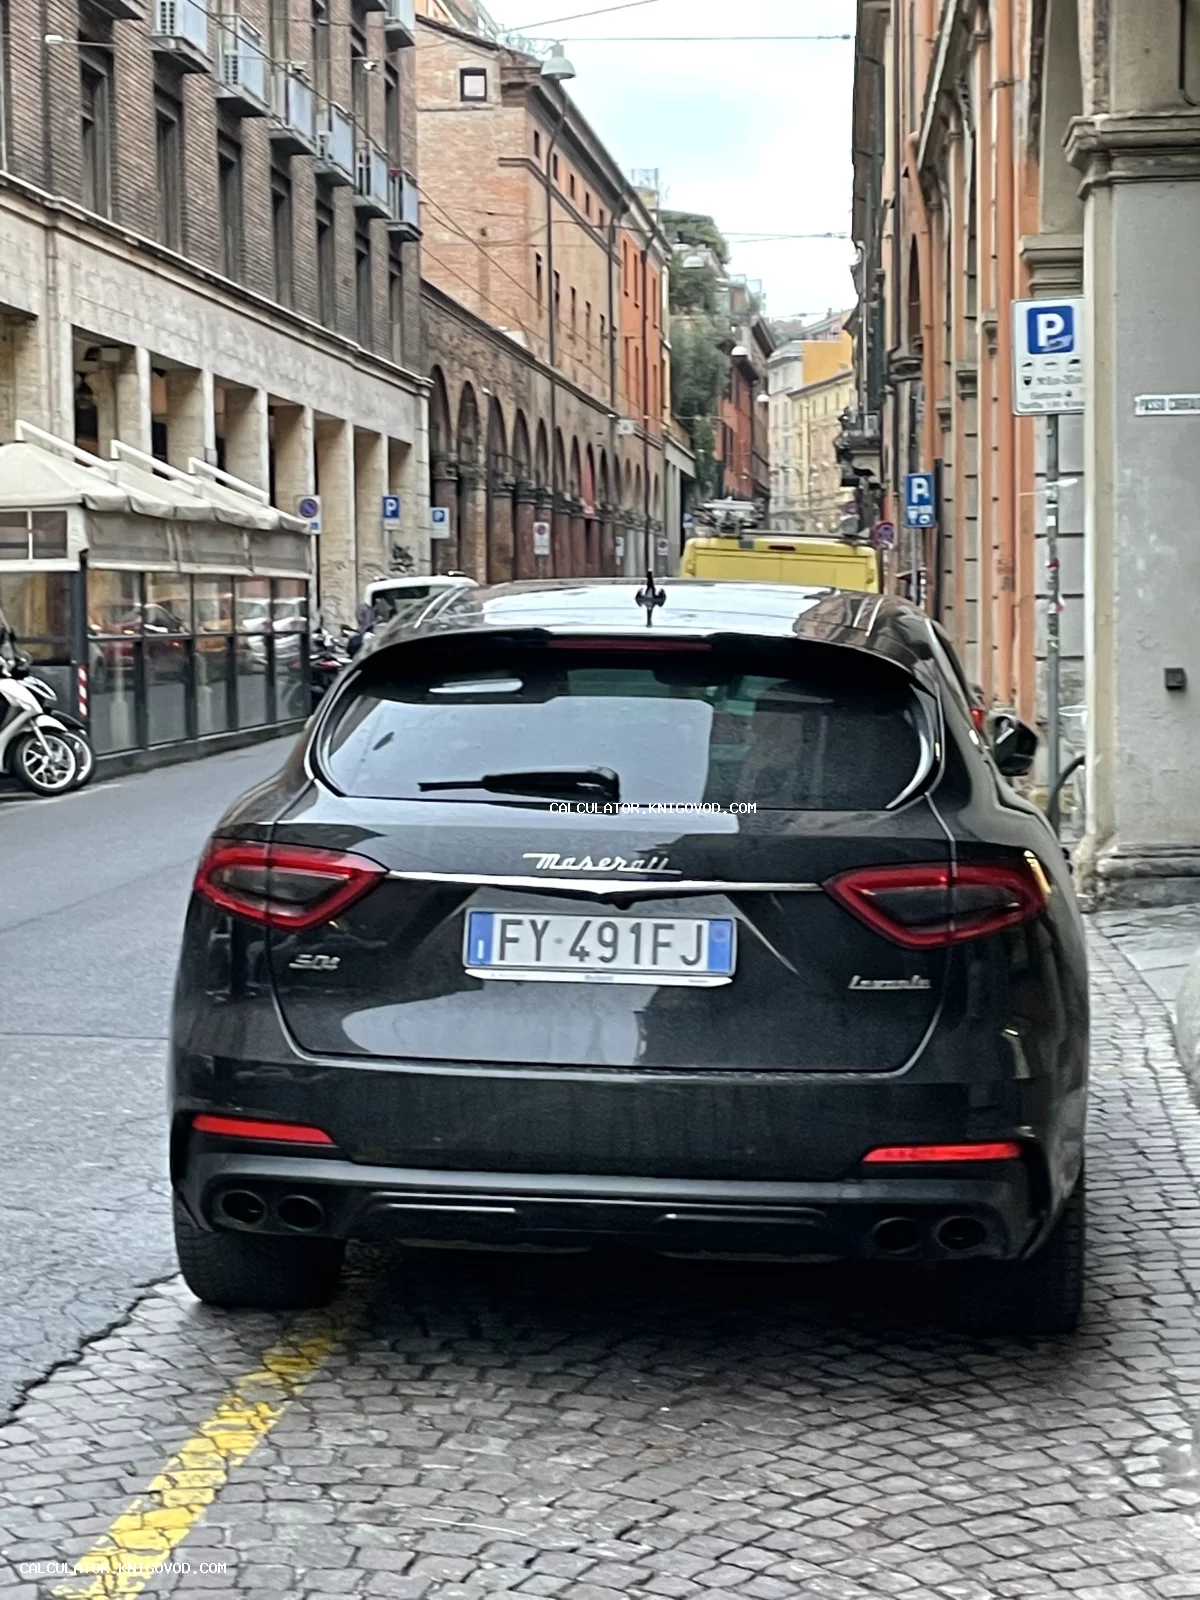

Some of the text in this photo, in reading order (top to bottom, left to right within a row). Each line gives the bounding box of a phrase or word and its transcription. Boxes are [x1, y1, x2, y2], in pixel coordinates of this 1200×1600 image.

[1036, 313, 1065, 347] P
[911, 477, 929, 504] P
[385, 498, 397, 516] P
[499, 918, 551, 962] FY
[568, 919, 704, 967] 491FJ
